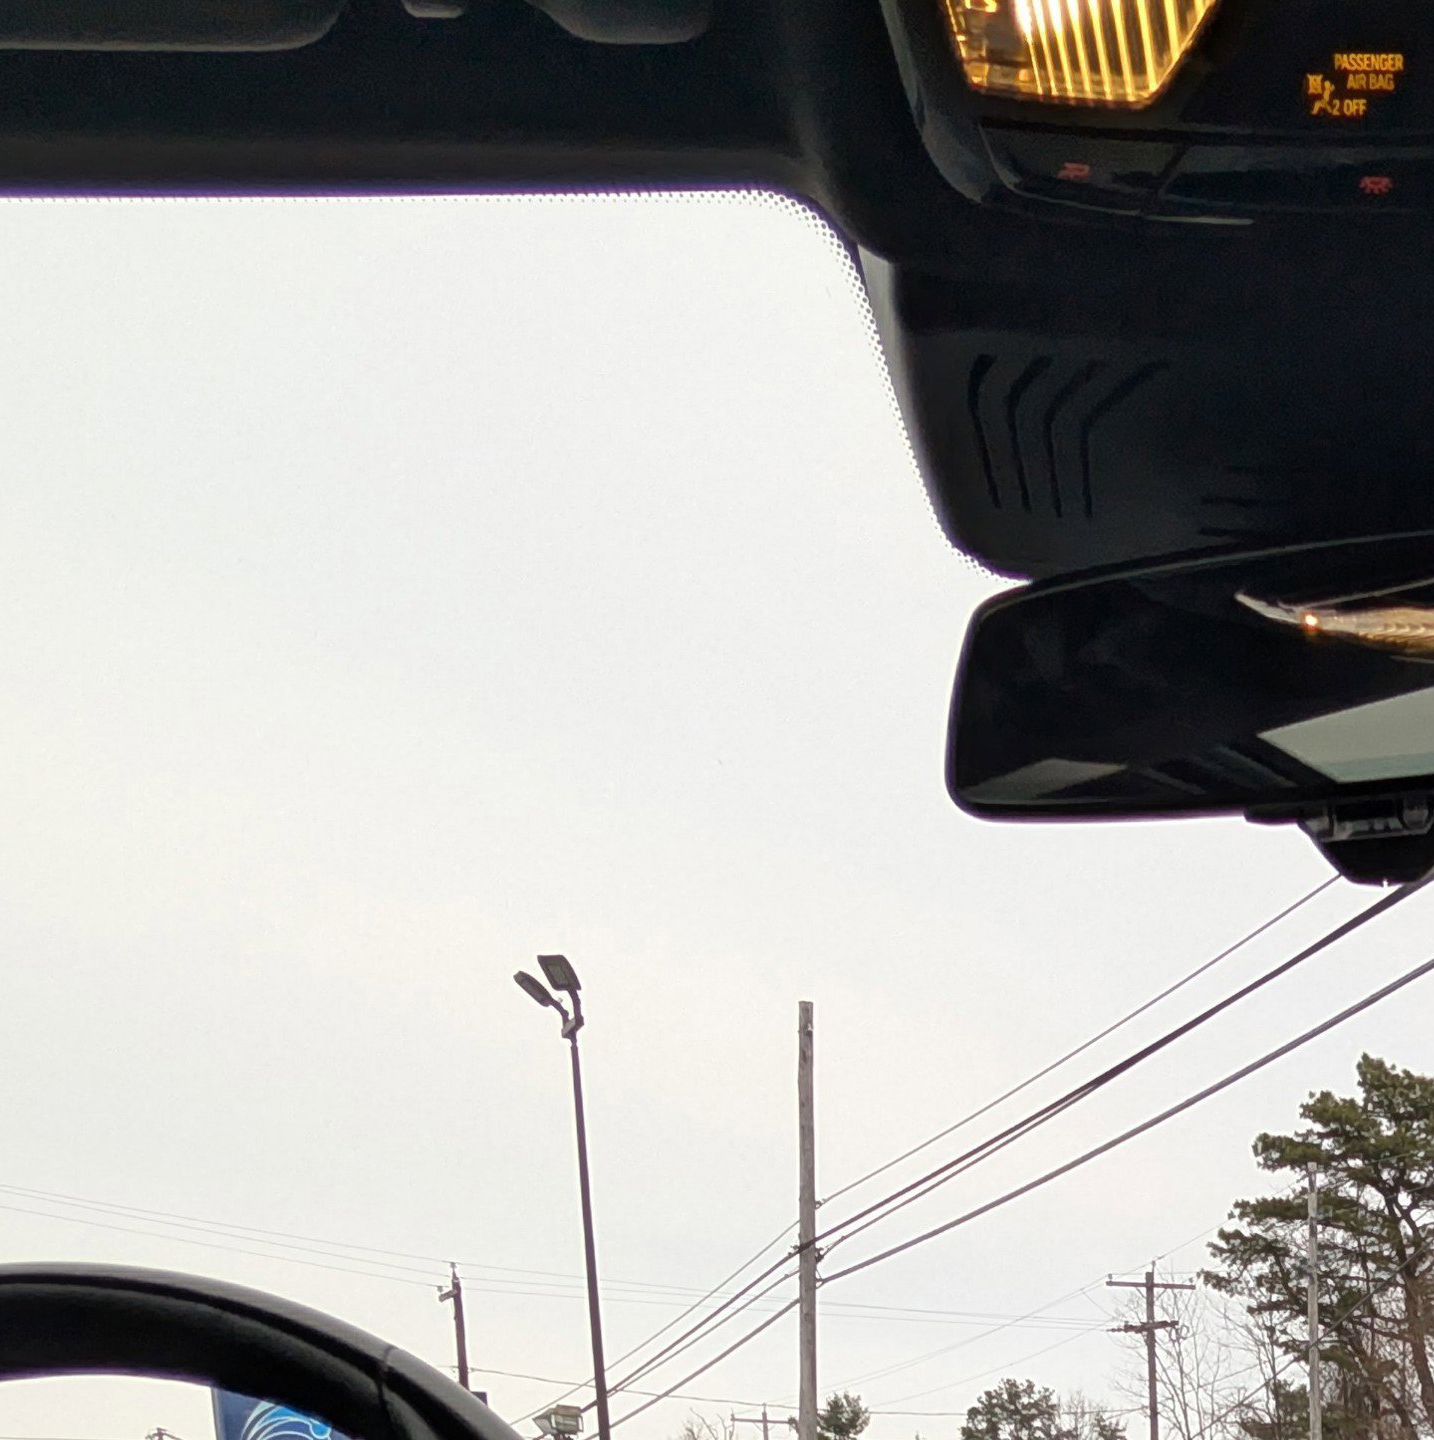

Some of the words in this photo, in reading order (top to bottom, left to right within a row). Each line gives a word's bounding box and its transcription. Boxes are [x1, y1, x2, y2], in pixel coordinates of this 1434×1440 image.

[1334, 53, 1404, 70] PASSENGER
[1347, 74, 1366, 89] AIR
[1369, 74, 1395, 90] BAG
[1343, 99, 1367, 115] OFF
